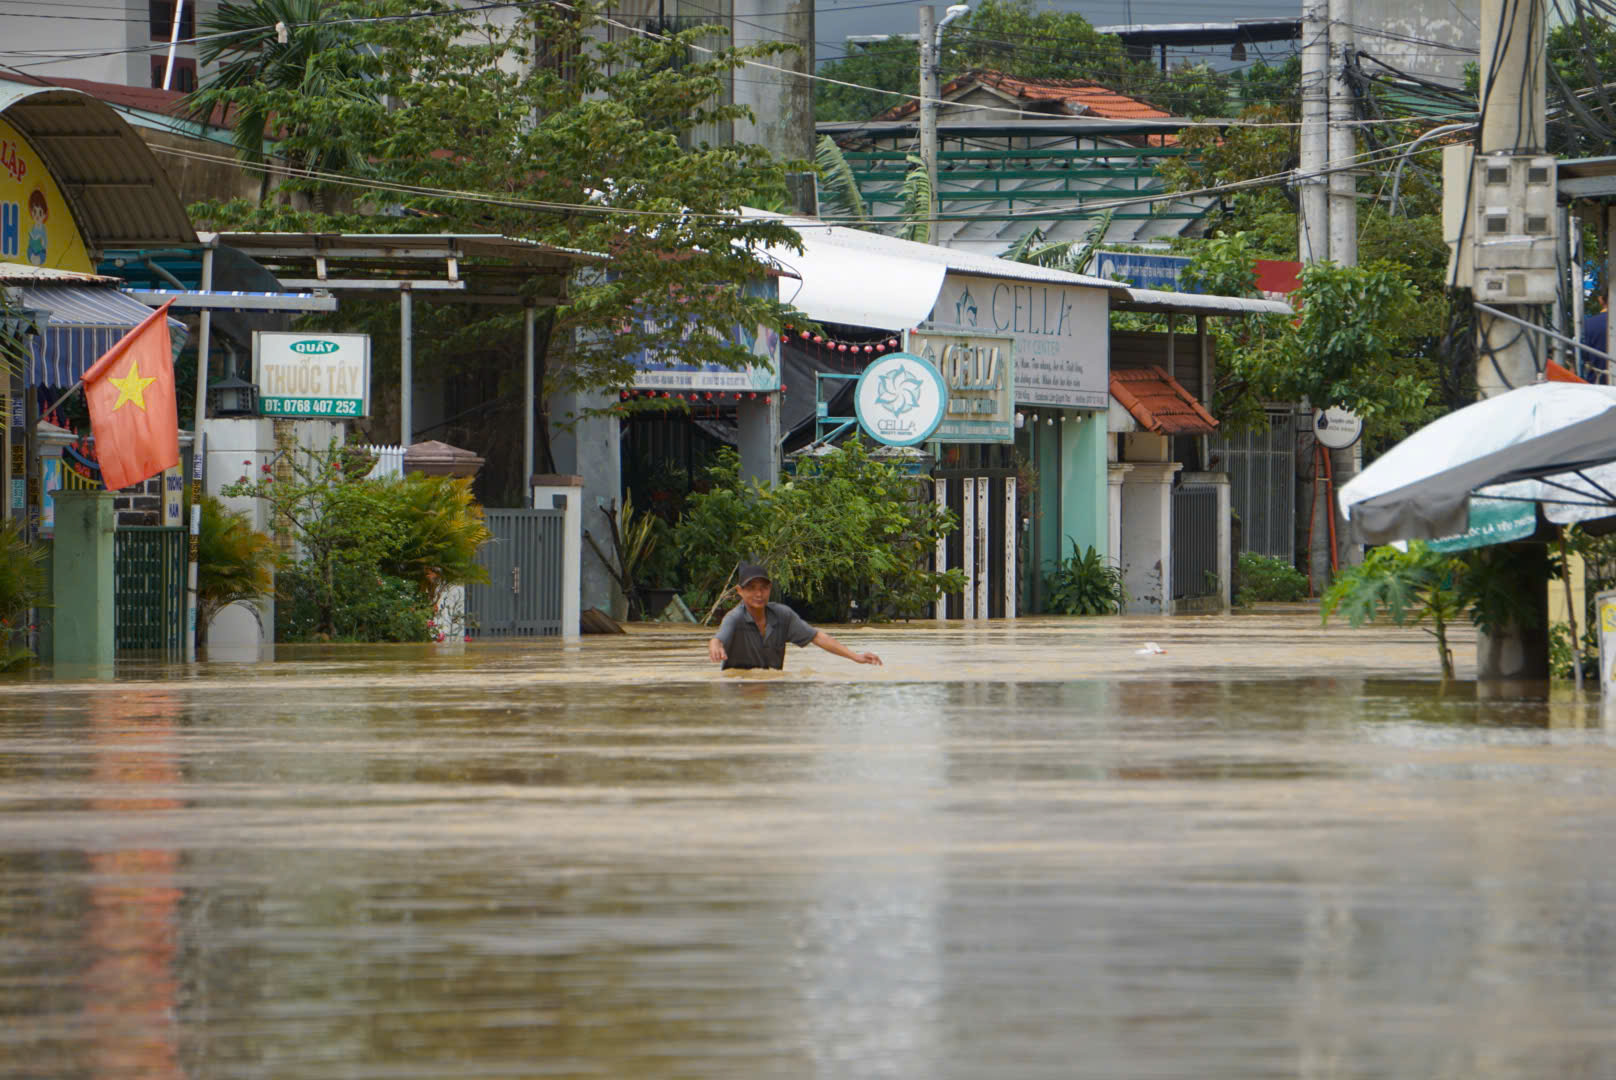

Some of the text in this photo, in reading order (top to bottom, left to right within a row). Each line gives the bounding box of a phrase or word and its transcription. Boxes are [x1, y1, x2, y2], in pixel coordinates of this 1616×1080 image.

[992, 283, 1072, 337] CELLA
[264, 357, 360, 395] THUỐC TÂY
[284, 400, 310, 413] 0768
[313, 400, 333, 413] 407
[335, 401, 356, 414] 252
[878, 419, 917, 431] CELLA
